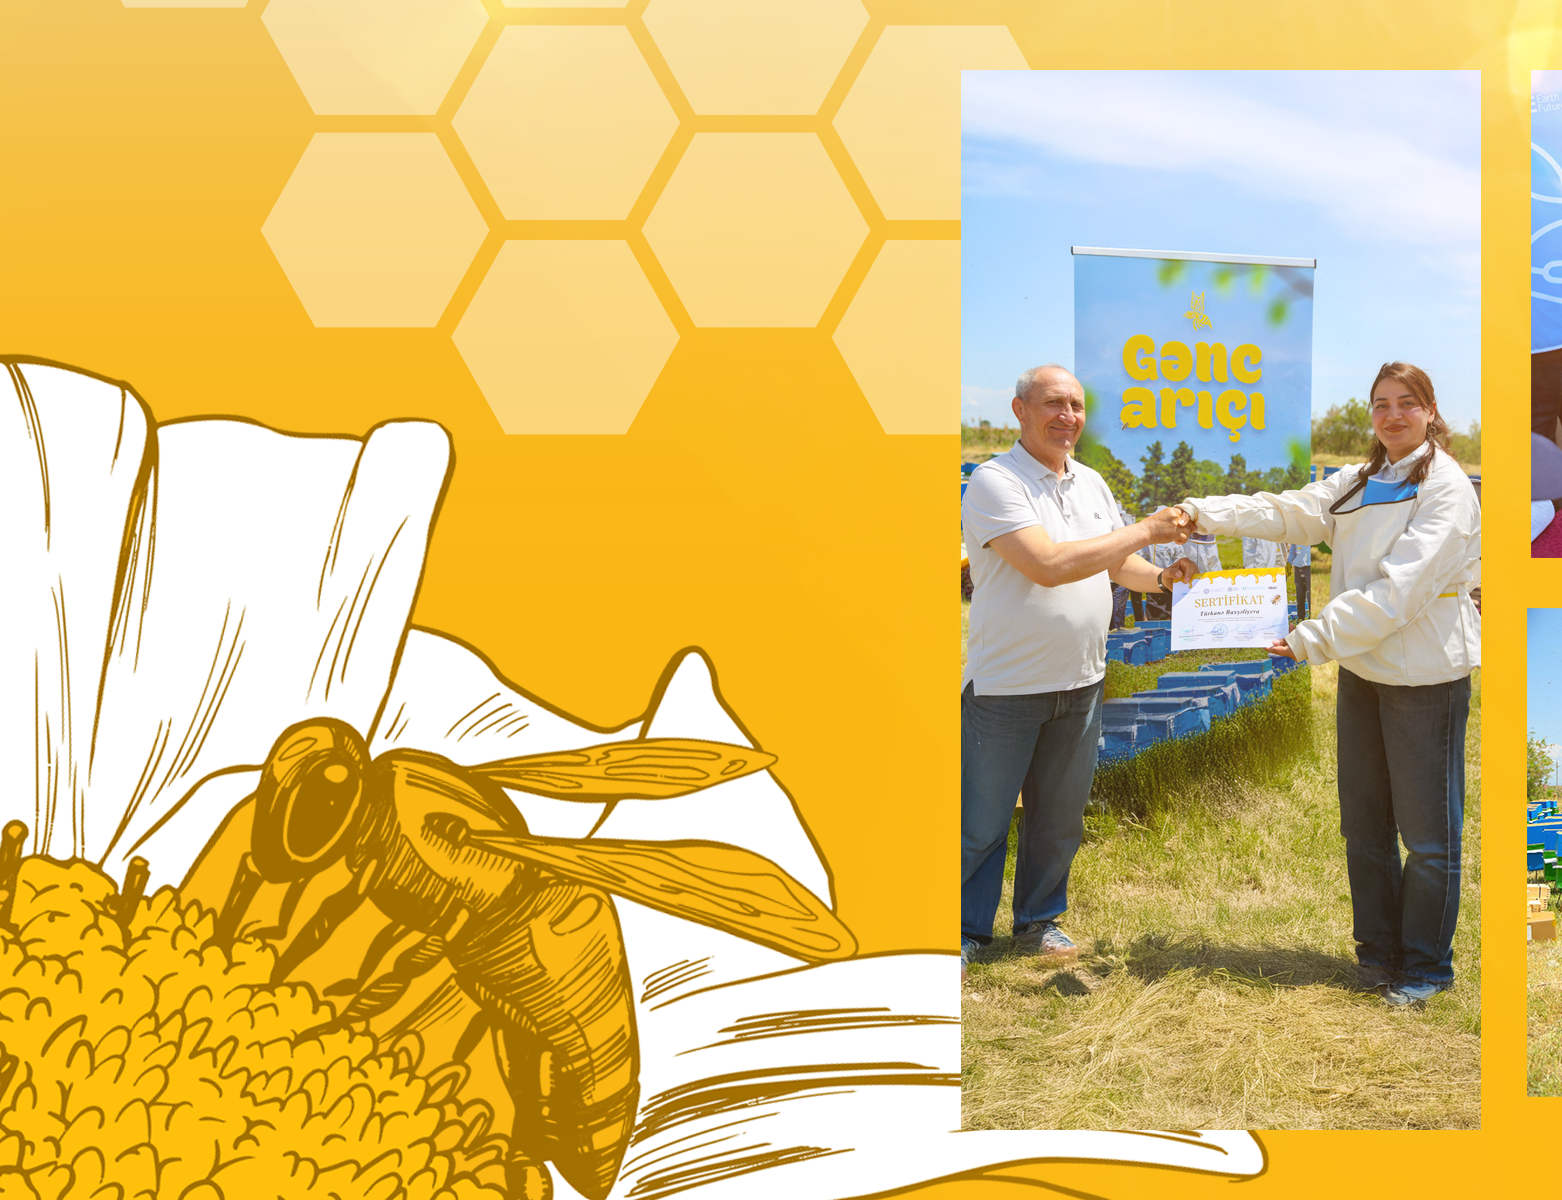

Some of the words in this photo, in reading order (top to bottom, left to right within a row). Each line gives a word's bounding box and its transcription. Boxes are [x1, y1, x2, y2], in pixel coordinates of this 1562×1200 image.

[1536, 93, 1560, 103] Earth
[1122, 334, 1262, 384] Gənc
[1120, 386, 1266, 443] arıçı
[1194, 593, 1265, 608] SERTİFİKAT
